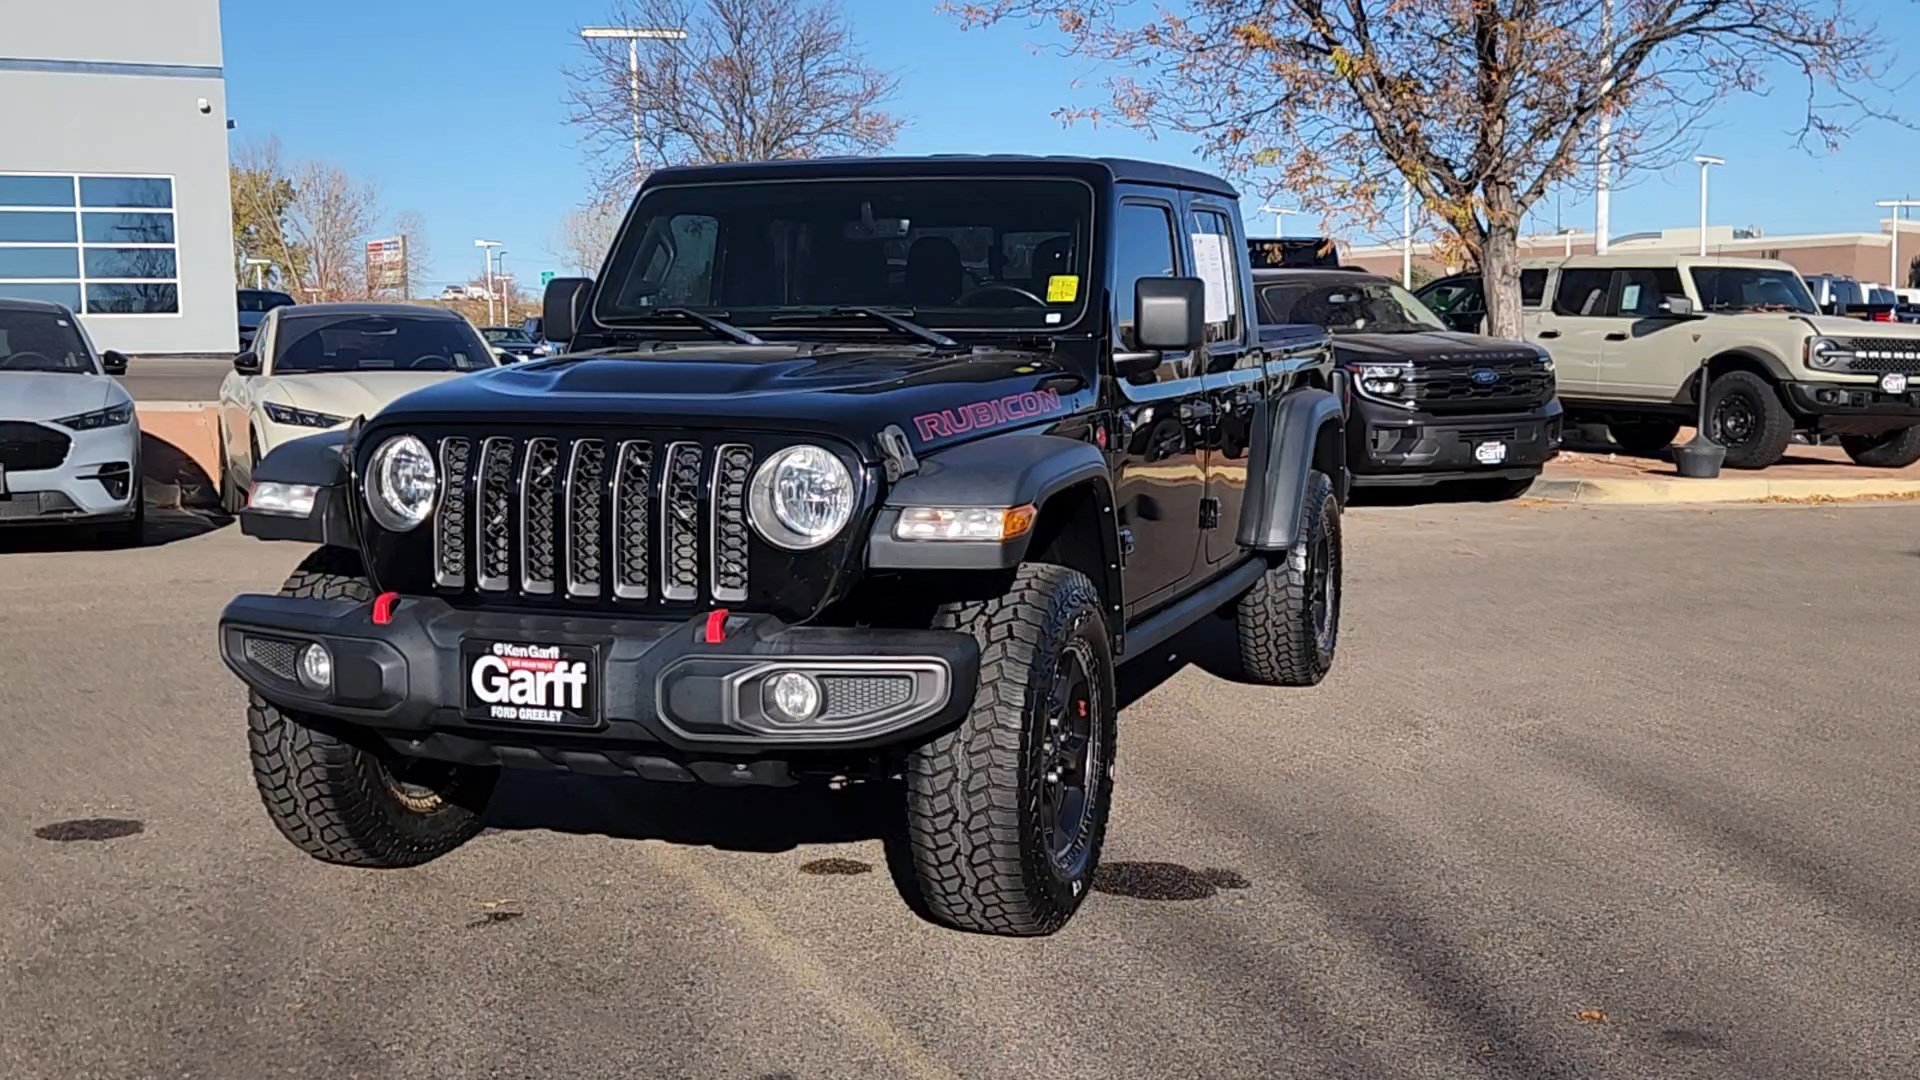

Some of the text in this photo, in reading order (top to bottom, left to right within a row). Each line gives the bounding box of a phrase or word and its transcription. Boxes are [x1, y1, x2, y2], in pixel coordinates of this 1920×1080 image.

[913, 387, 1062, 442] RUBICON
[504, 643, 560, 660] Ken Garff
[471, 654, 588, 709] Garff
[490, 705, 563, 723] FORD GREELEY
